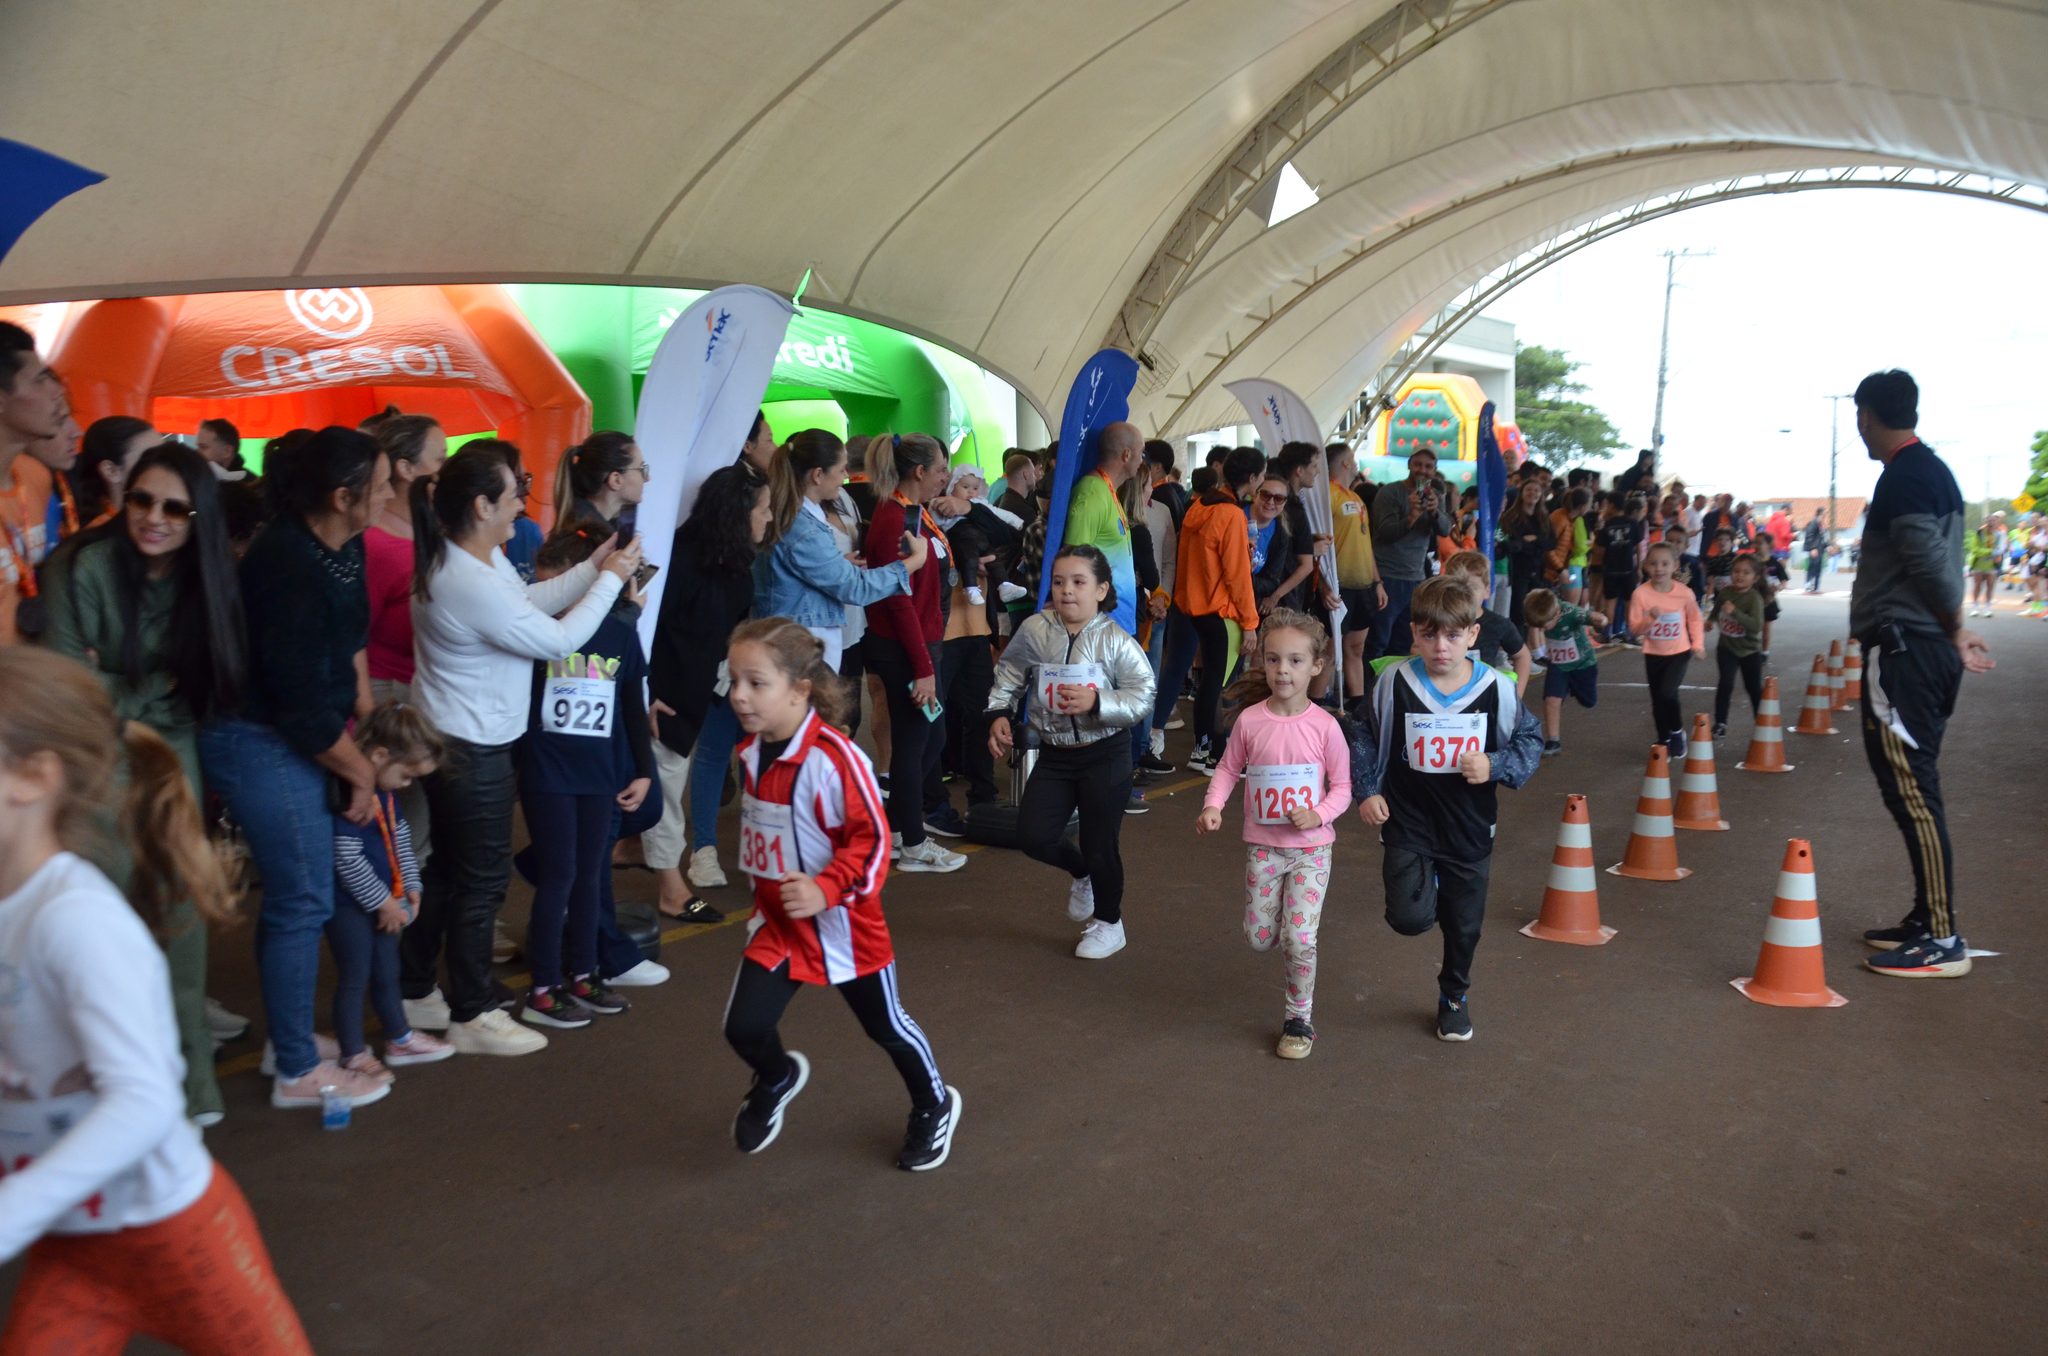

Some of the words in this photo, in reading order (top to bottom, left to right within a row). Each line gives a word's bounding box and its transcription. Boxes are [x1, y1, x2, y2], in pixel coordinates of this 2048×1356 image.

[220, 345, 476, 388] CRESOL
[776, 335, 854, 374] redi
[554, 698, 606, 731] 922
[1255, 786, 1314, 819] 1263
